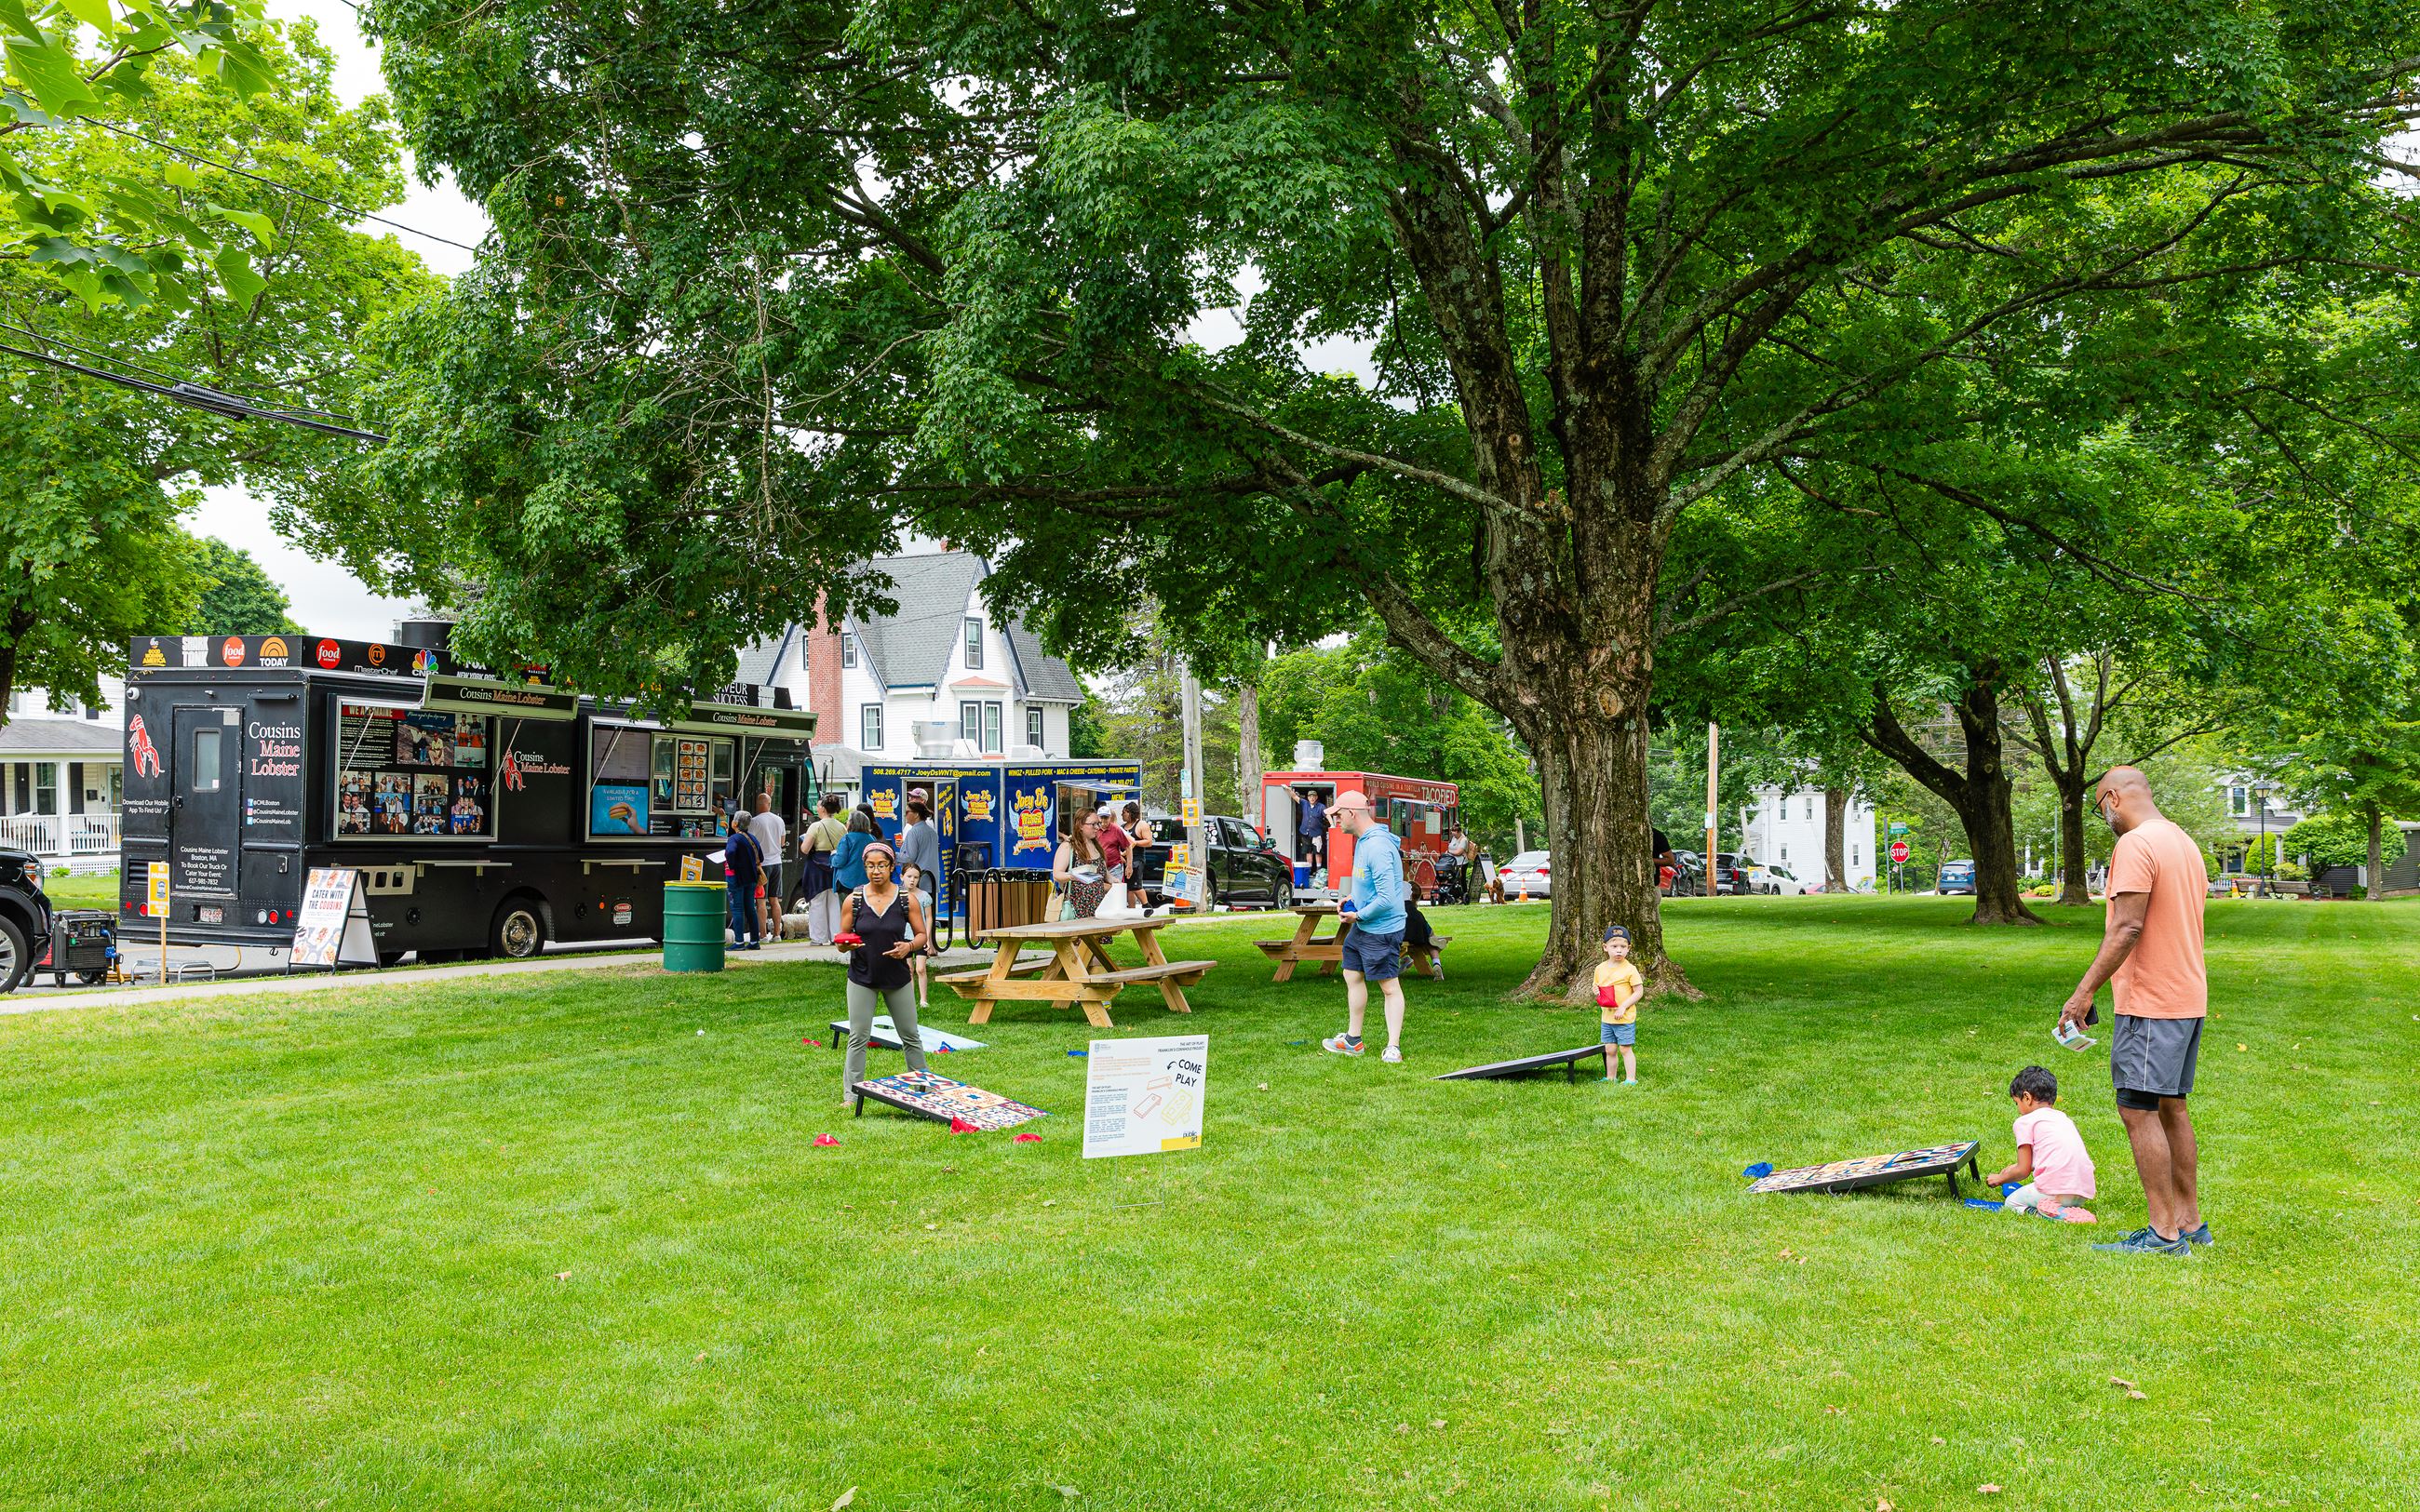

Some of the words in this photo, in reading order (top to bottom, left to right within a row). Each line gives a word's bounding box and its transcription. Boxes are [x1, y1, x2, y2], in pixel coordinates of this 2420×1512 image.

[224, 644, 245, 661] food
[317, 646, 341, 662] food
[260, 658, 289, 667] TODAY
[355, 664, 398, 676] MasterChef
[457, 671, 470, 679] NEW
[470, 672, 484, 680] YORK
[460, 687, 492, 701] Cousins
[492, 689, 517, 703] Maine
[517, 692, 546, 706] Lobster
[713, 693, 747, 706] SUCCESS
[349, 706, 359, 716] WE
[373, 707, 393, 717] MAINE
[713, 712, 737, 723] Cousins
[737, 714, 755, 725] Maine
[755, 716, 777, 727] Lobster
[249, 721, 301, 739] Cousins
[260, 740, 300, 757] Maine
[514, 751, 544, 763] Cousins
[251, 758, 300, 776] Lobster
[520, 762, 543, 773] Maine
[544, 763, 571, 774] Lobster
[916, 769, 991, 778] JoeyDsWNT@gmail.com
[1380, 782, 1394, 790] CUISINE
[1015, 790, 1034, 811] Joey
[1034, 786, 1049, 810] D's
[1421, 786, 1456, 805] TACOFIED
[1891, 848, 1908, 856] STOP
[175, 884, 232, 892] Boston@CousinsMaineLobster.com
[312, 890, 329, 899] CATER
[329, 890, 345, 900] WITH
[308, 900, 318, 910] THE
[318, 901, 343, 911] COUSINS
[1178, 1059, 1202, 1074] COME
[1176, 1073, 1197, 1087] PLAY
